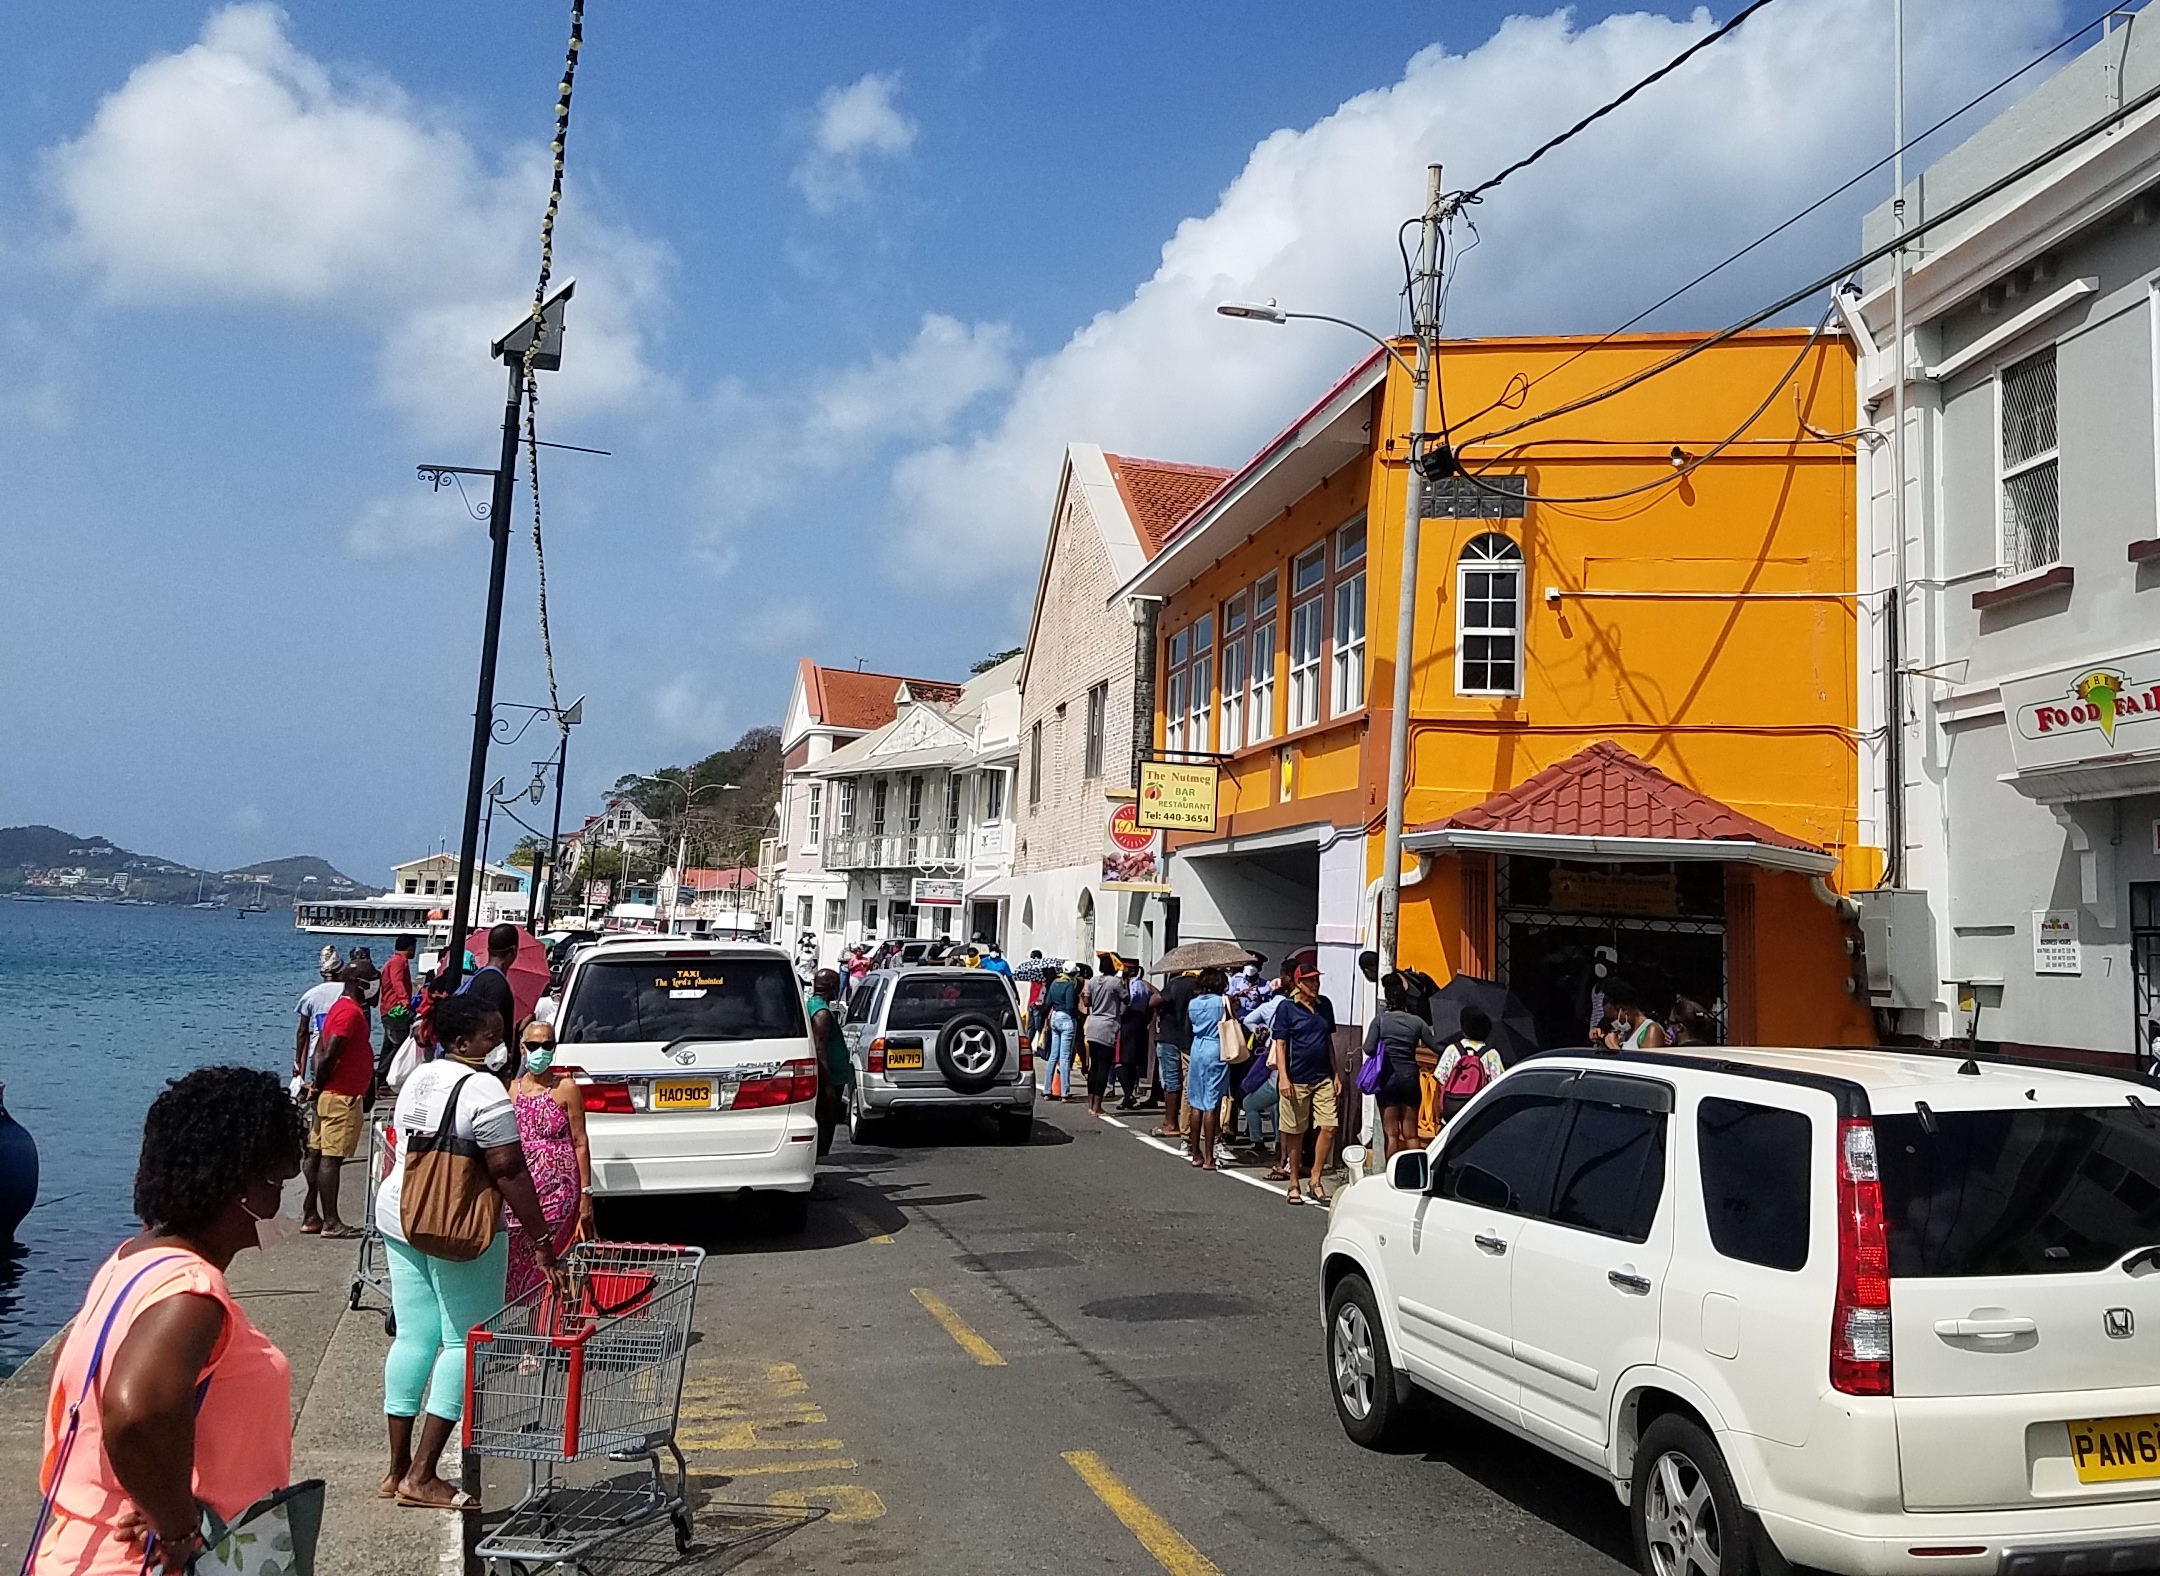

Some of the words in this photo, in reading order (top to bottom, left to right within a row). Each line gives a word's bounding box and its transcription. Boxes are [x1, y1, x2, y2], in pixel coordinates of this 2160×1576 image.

[2085, 675, 2110, 689] THE
[2034, 702, 2102, 733] FOOD
[1146, 770, 1166, 781] The
[1171, 771, 1211, 786] Nutmeg
[1175, 787, 1196, 797] BAR
[1158, 800, 1211, 811] RESTAURANT
[1144, 810, 1162, 821] Tel:
[1163, 812, 1209, 823] 440-3654
[676, 970, 700, 978] TAXI
[655, 978, 668, 987] The
[2074, 1430, 2160, 1468] PAN6
